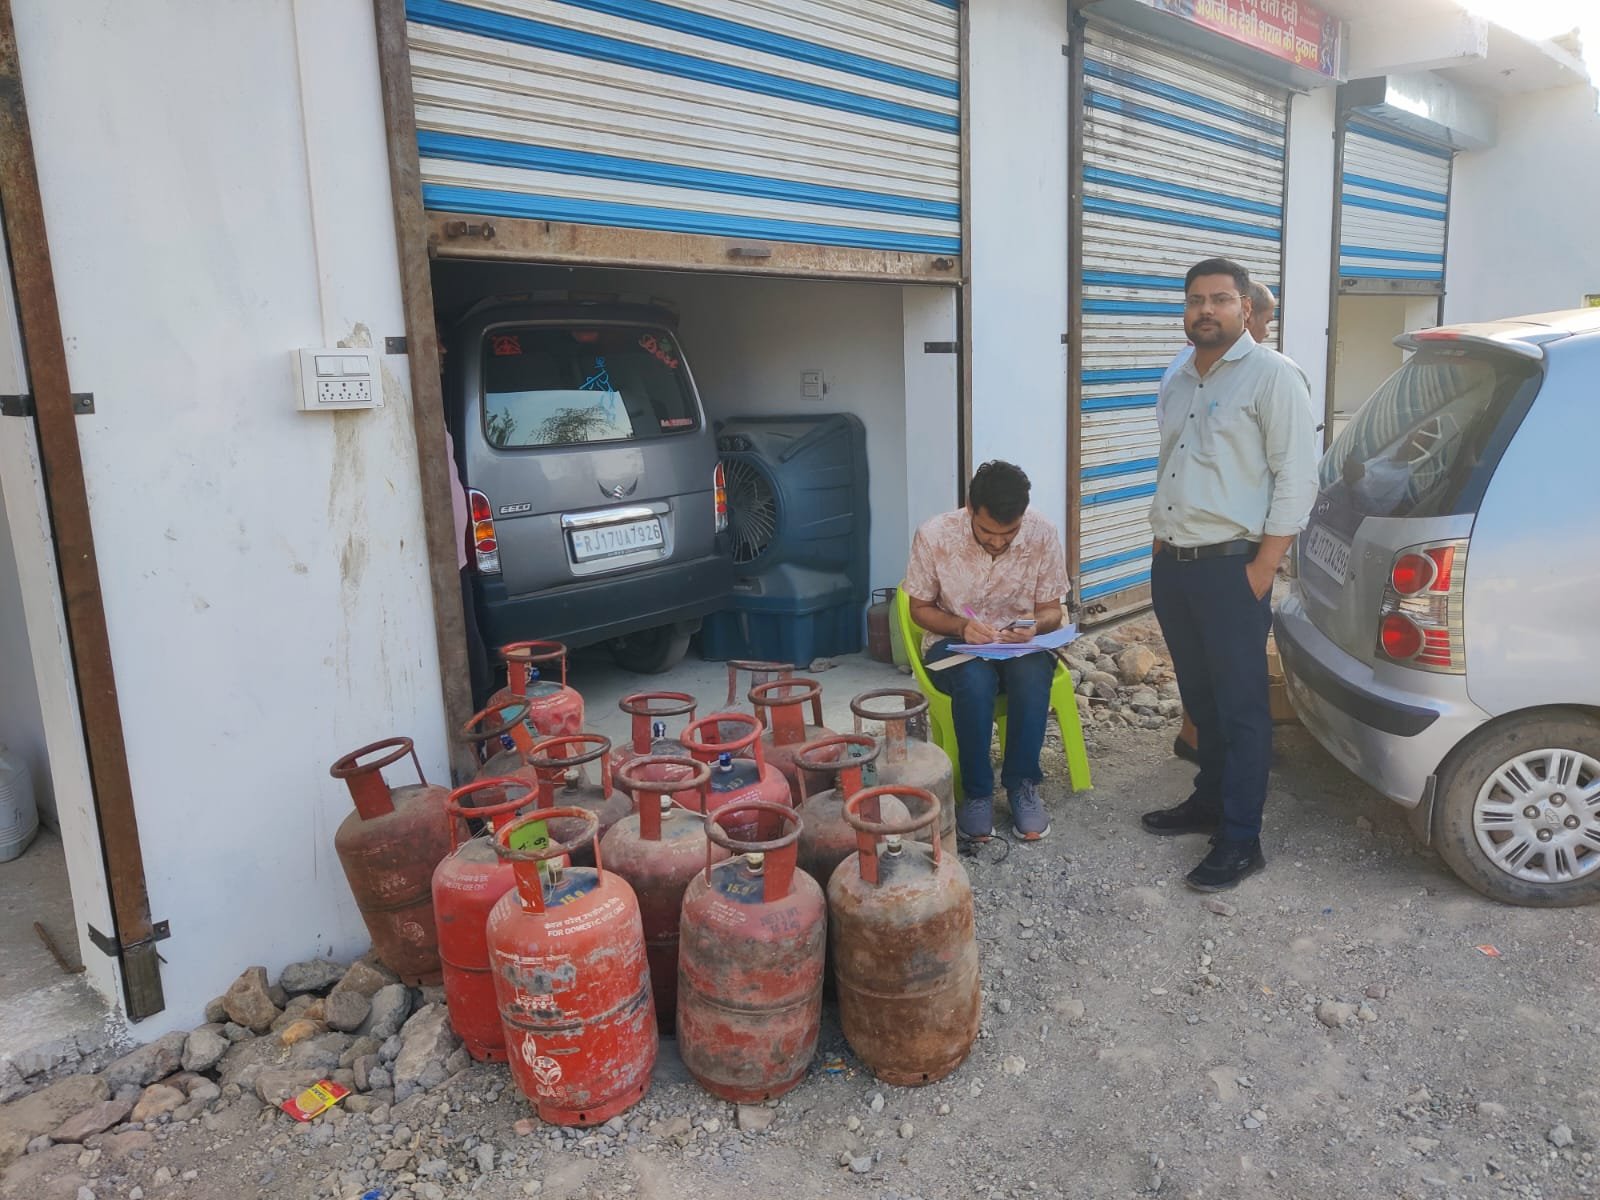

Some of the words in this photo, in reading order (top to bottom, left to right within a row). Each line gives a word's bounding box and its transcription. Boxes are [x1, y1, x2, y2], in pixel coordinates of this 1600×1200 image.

[1283, 25, 1295, 52] की
[1295, 35, 1319, 64] दुकान
[500, 503, 531, 514] EECO
[548, 929, 564, 937] FOR
[565, 918, 602, 935] DOMESTIC
